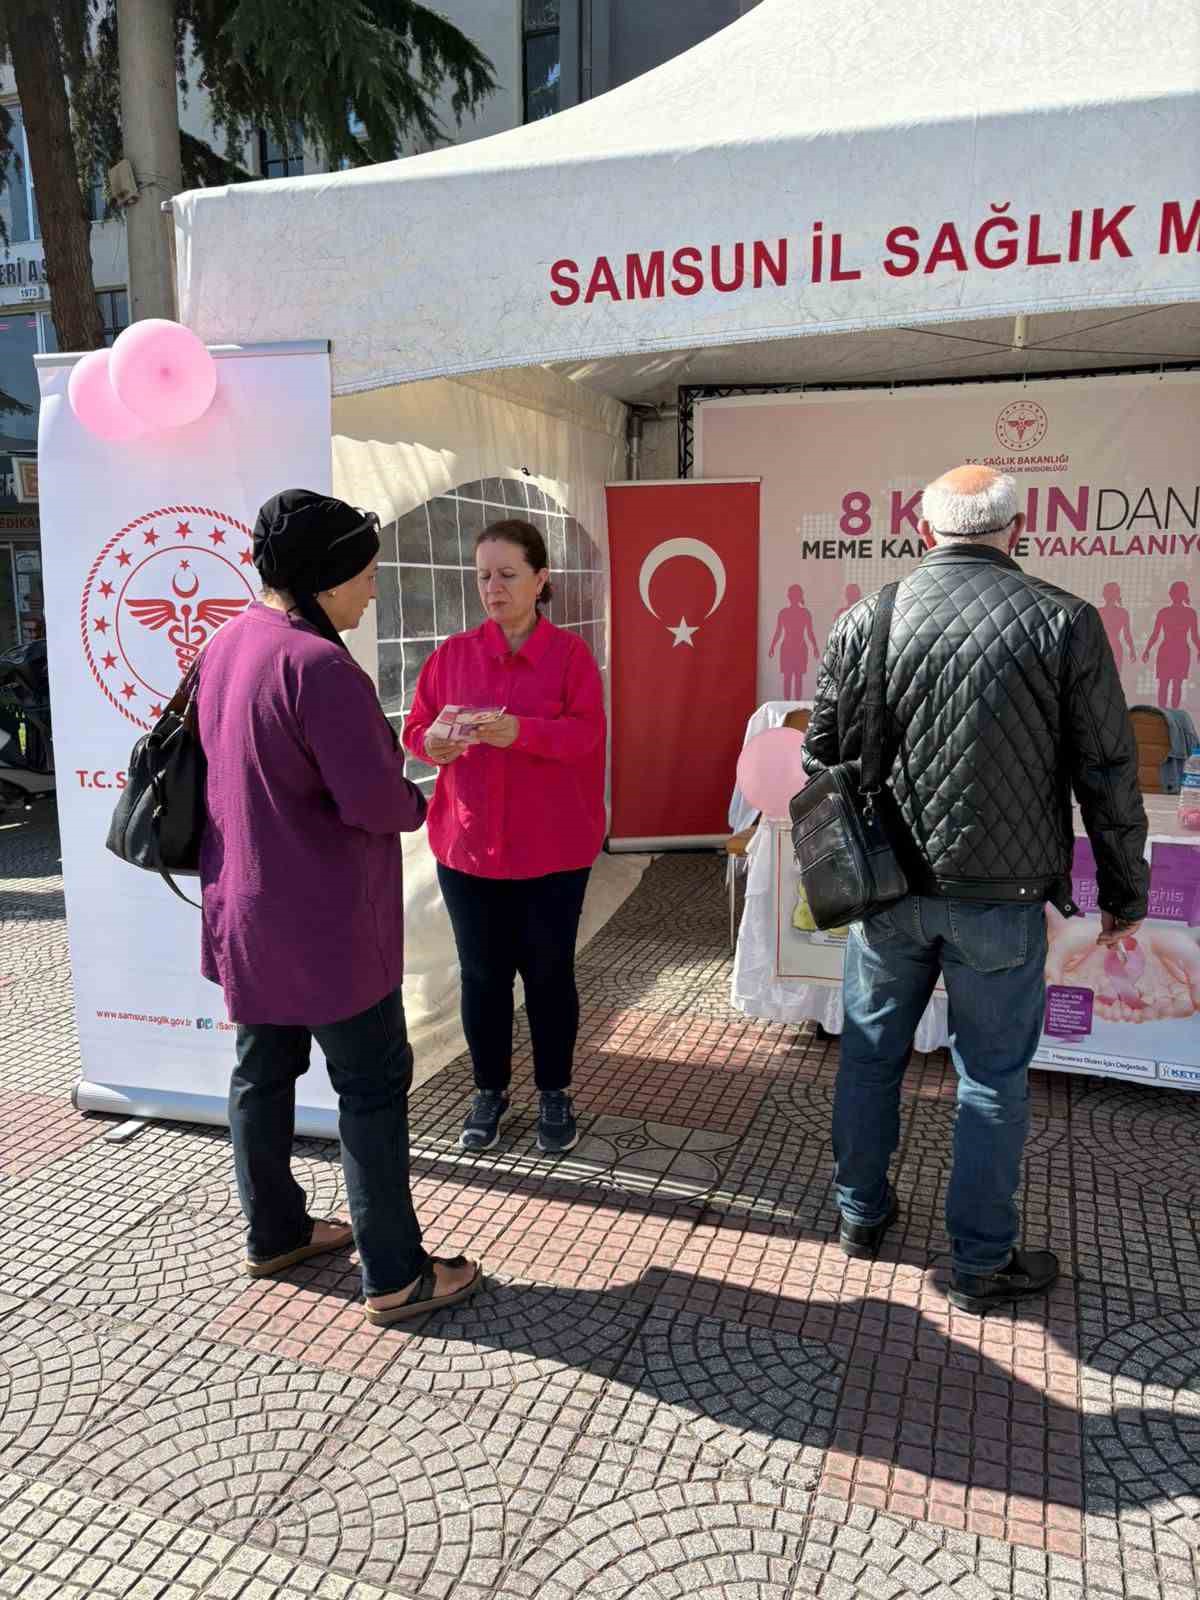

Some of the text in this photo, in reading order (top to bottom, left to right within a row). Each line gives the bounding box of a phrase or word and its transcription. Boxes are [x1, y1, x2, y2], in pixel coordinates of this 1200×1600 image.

[549, 238, 788, 306] SAMSUN
[811, 221, 862, 283] İL
[883, 201, 1137, 277] SAĞLIK
[983, 454, 1018, 466] SAĞLIK
[1019, 452, 1070, 465] BAKANLIĞI
[839, 490, 872, 536] 8
[801, 540, 873, 560] MEME
[1034, 533, 1200, 556] YAKALANIY
[75, 770, 112, 788] T.C.
